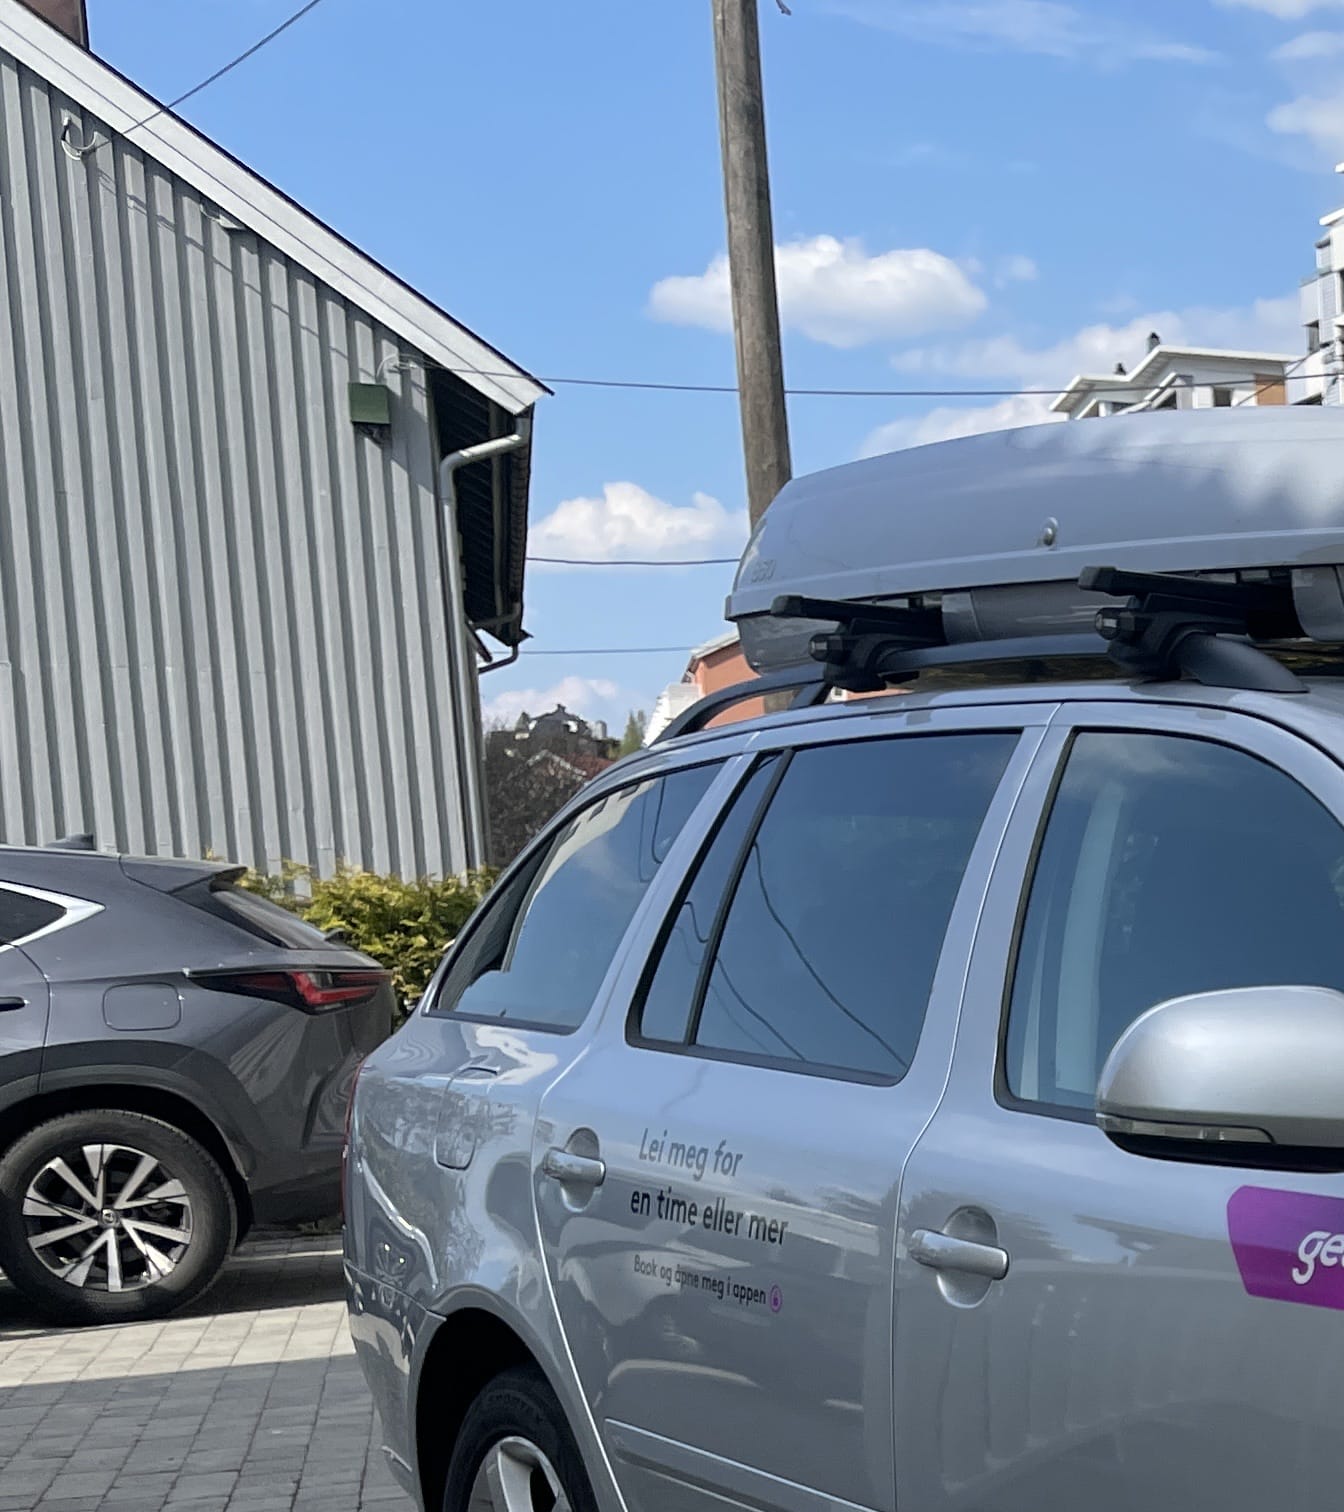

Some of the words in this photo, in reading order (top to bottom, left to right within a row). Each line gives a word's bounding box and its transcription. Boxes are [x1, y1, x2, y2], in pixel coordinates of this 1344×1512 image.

[639, 1127, 667, 1162] Lei
[668, 1142, 708, 1181] meg
[713, 1139, 743, 1176] for
[630, 1189, 651, 1216] en
[656, 1186, 698, 1226] time
[703, 1197, 745, 1236] eller
[748, 1213, 789, 1245] mer
[633, 1254, 657, 1277] Book
[660, 1266, 672, 1286] og
[674, 1263, 699, 1288] åpne
[702, 1275, 724, 1299] meg
[733, 1284, 767, 1306] appen
